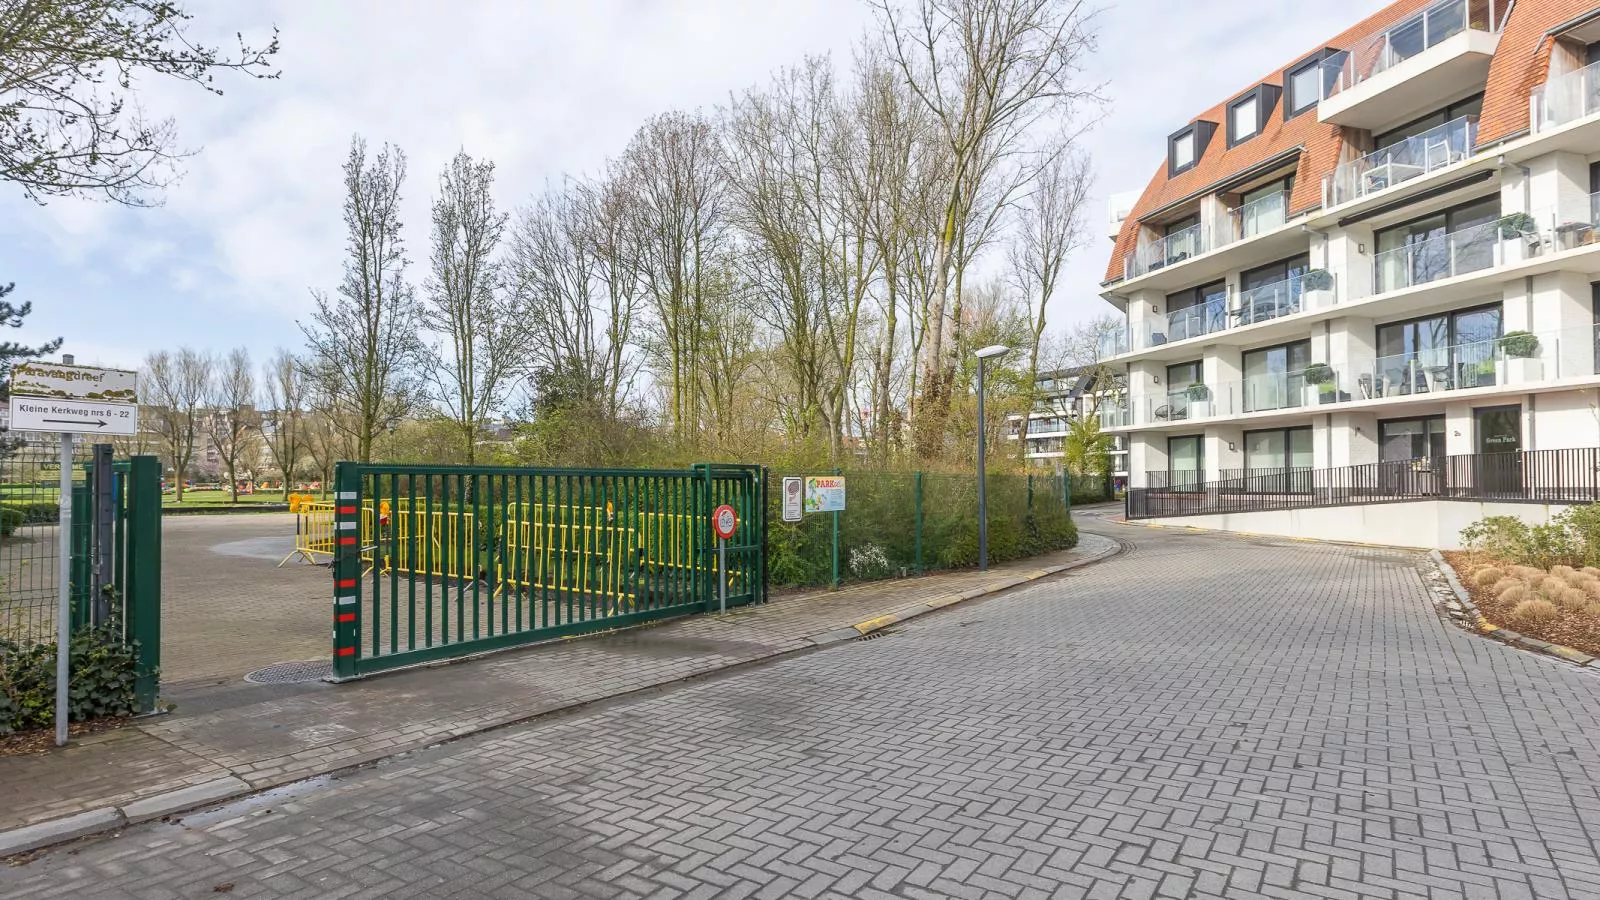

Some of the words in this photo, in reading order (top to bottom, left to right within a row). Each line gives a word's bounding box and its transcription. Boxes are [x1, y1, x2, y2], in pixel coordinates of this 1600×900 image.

[19, 404, 49, 413] Kleine
[51, 406, 89, 417] Kerkweg
[119, 411, 130, 419] 22
